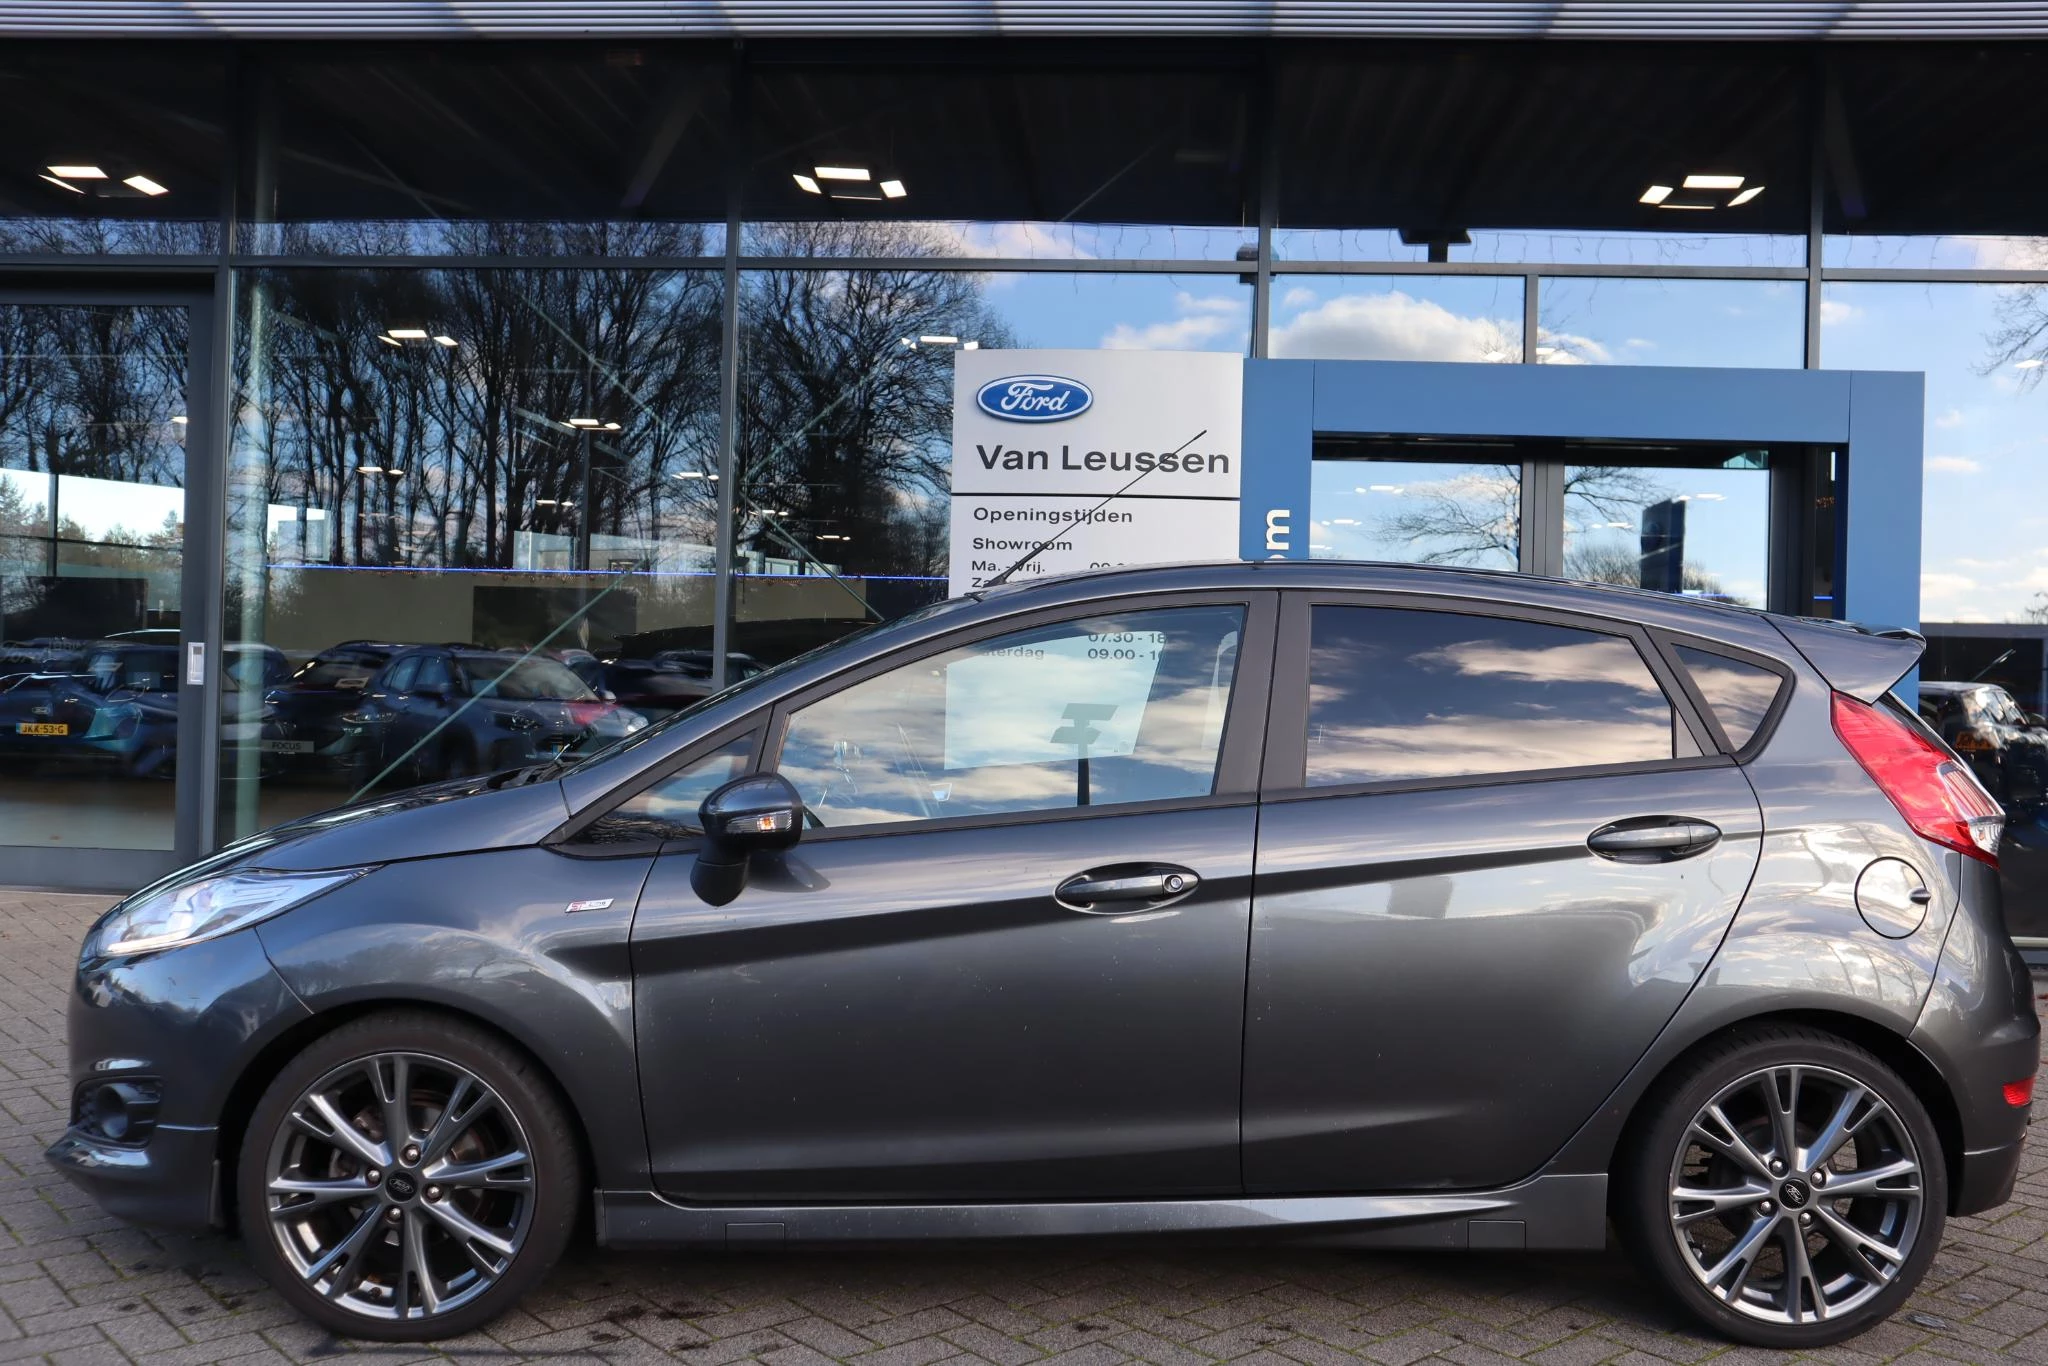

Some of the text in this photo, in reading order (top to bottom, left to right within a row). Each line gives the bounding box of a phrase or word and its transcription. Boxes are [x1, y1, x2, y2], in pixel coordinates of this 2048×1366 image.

[1001, 382, 1070, 411] Ford
[976, 445, 1230, 474] Van Leussen
[974, 507, 1133, 525] Openingstijden
[972, 537, 1072, 551] Showroom
[971, 560, 1001, 572] Ma.
[1088, 632, 1134, 643] 07.30
[1087, 648, 1136, 660] 09.00
